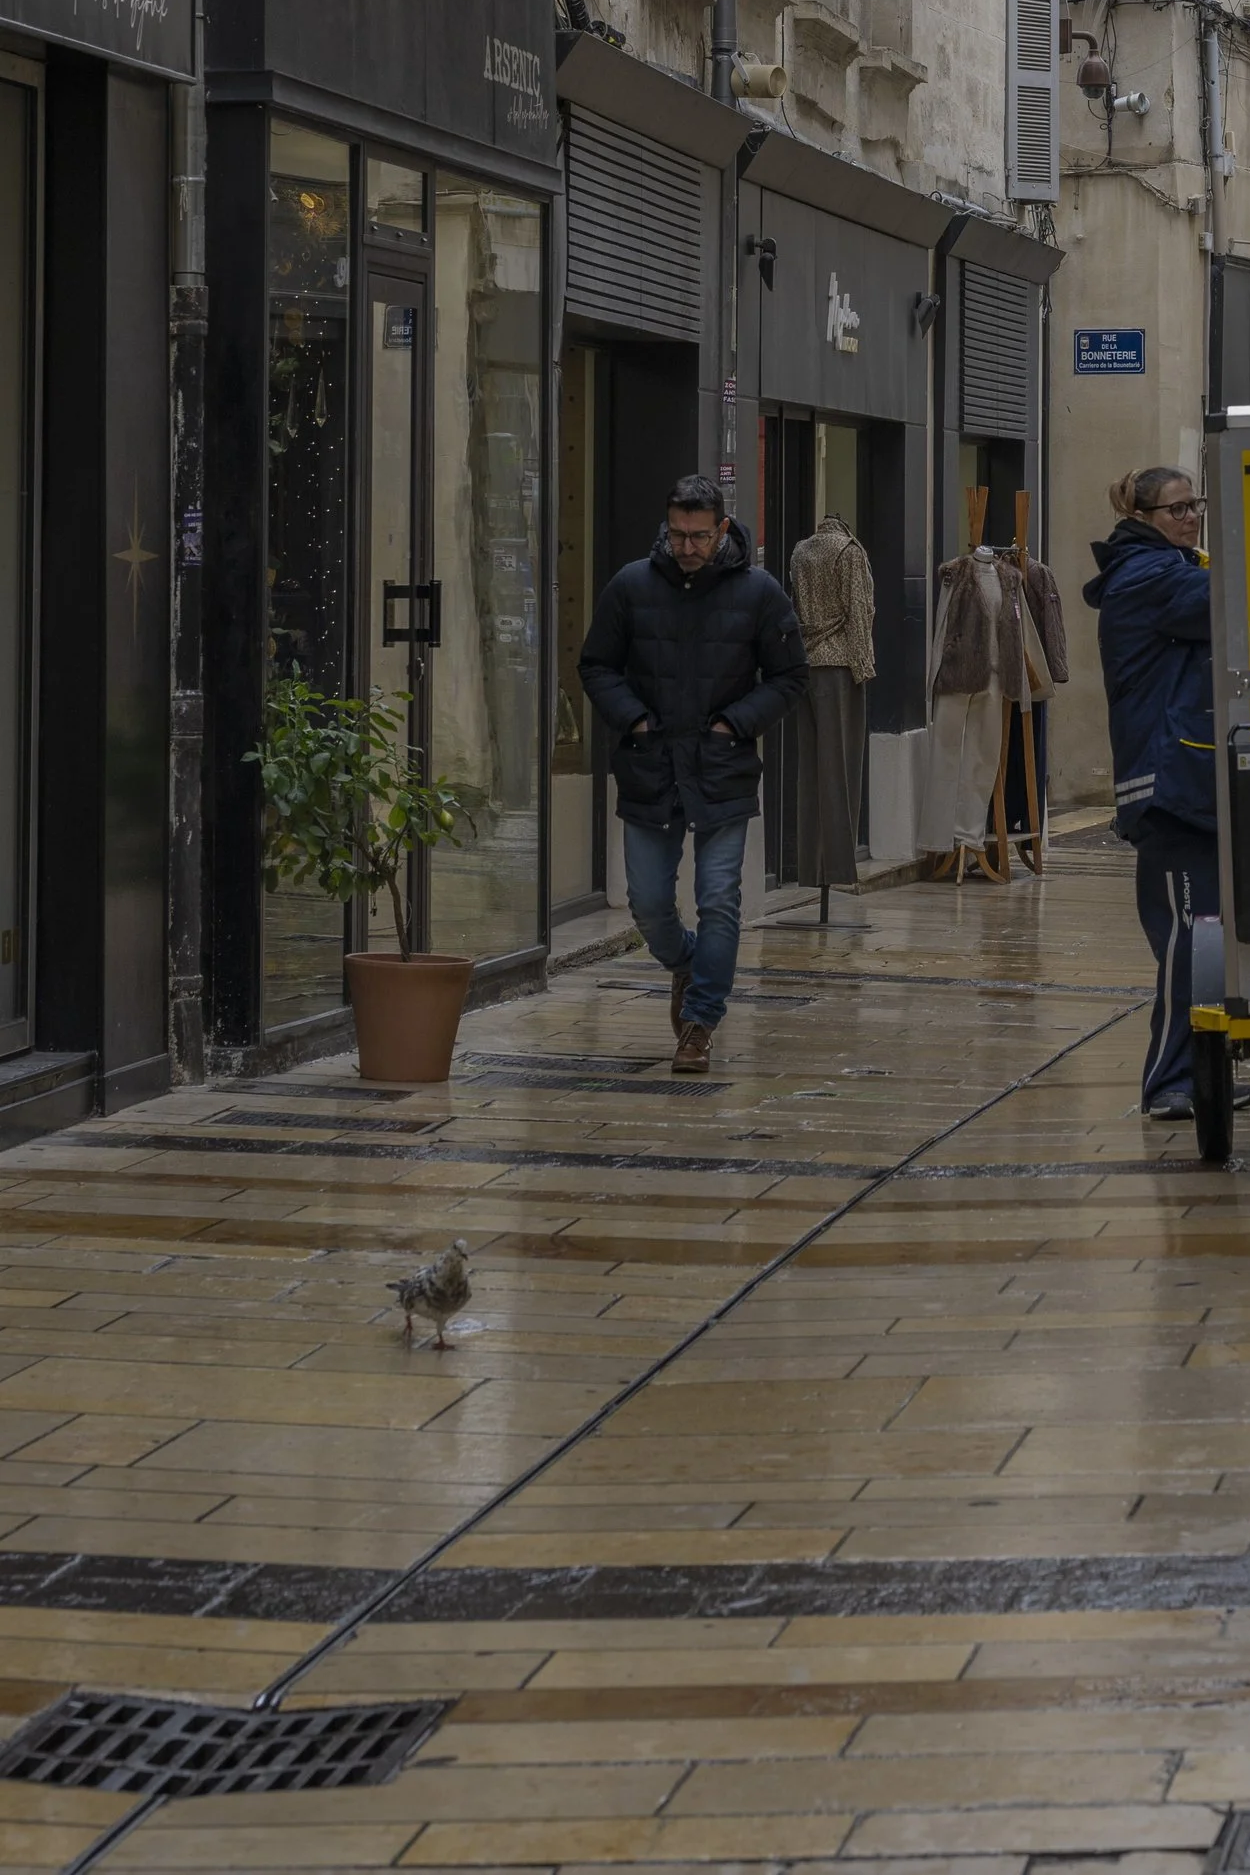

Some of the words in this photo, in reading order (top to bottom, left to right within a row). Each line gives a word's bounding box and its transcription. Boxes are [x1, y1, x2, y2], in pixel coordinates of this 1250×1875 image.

[483, 35, 541, 98] ARSENIC
[1102, 334, 1117, 342] RUE
[1081, 350, 1137, 361] BONNETERIE
